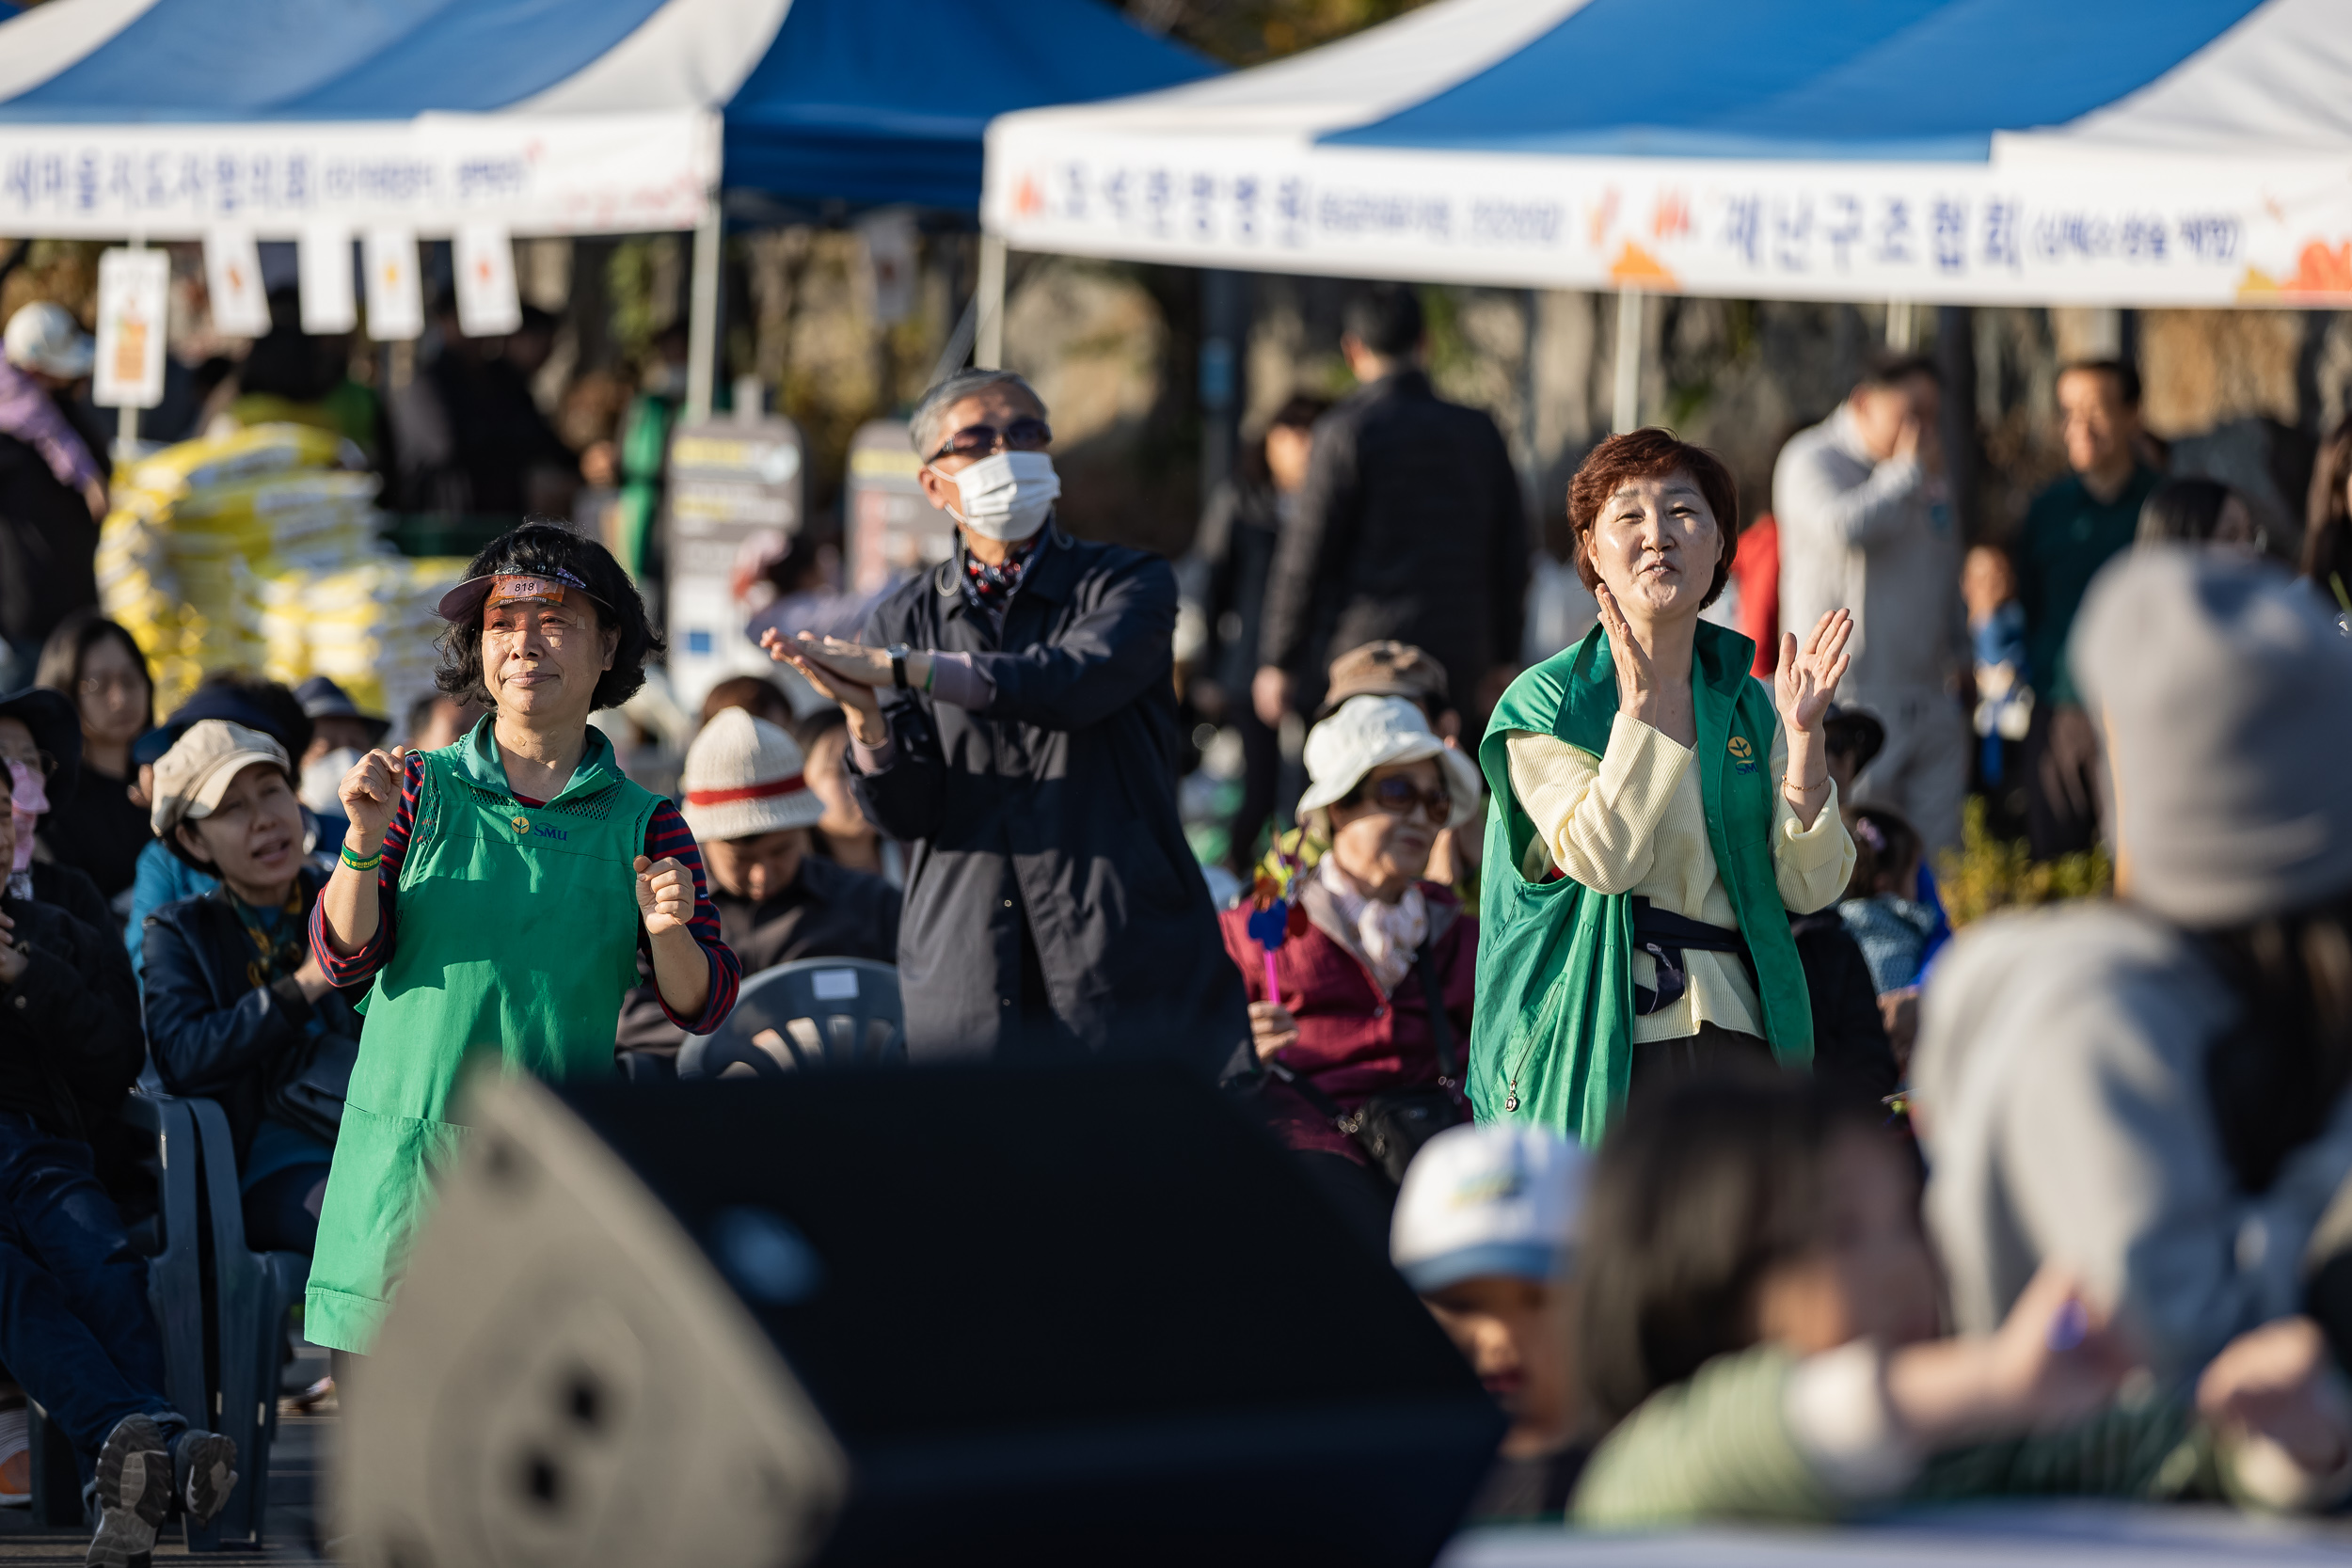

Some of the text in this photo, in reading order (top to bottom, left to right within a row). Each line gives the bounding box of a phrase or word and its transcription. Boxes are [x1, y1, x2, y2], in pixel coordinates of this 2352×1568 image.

[515, 582, 535, 592] 818
[1735, 762, 1758, 775] SM
[532, 824, 568, 842] SMU
